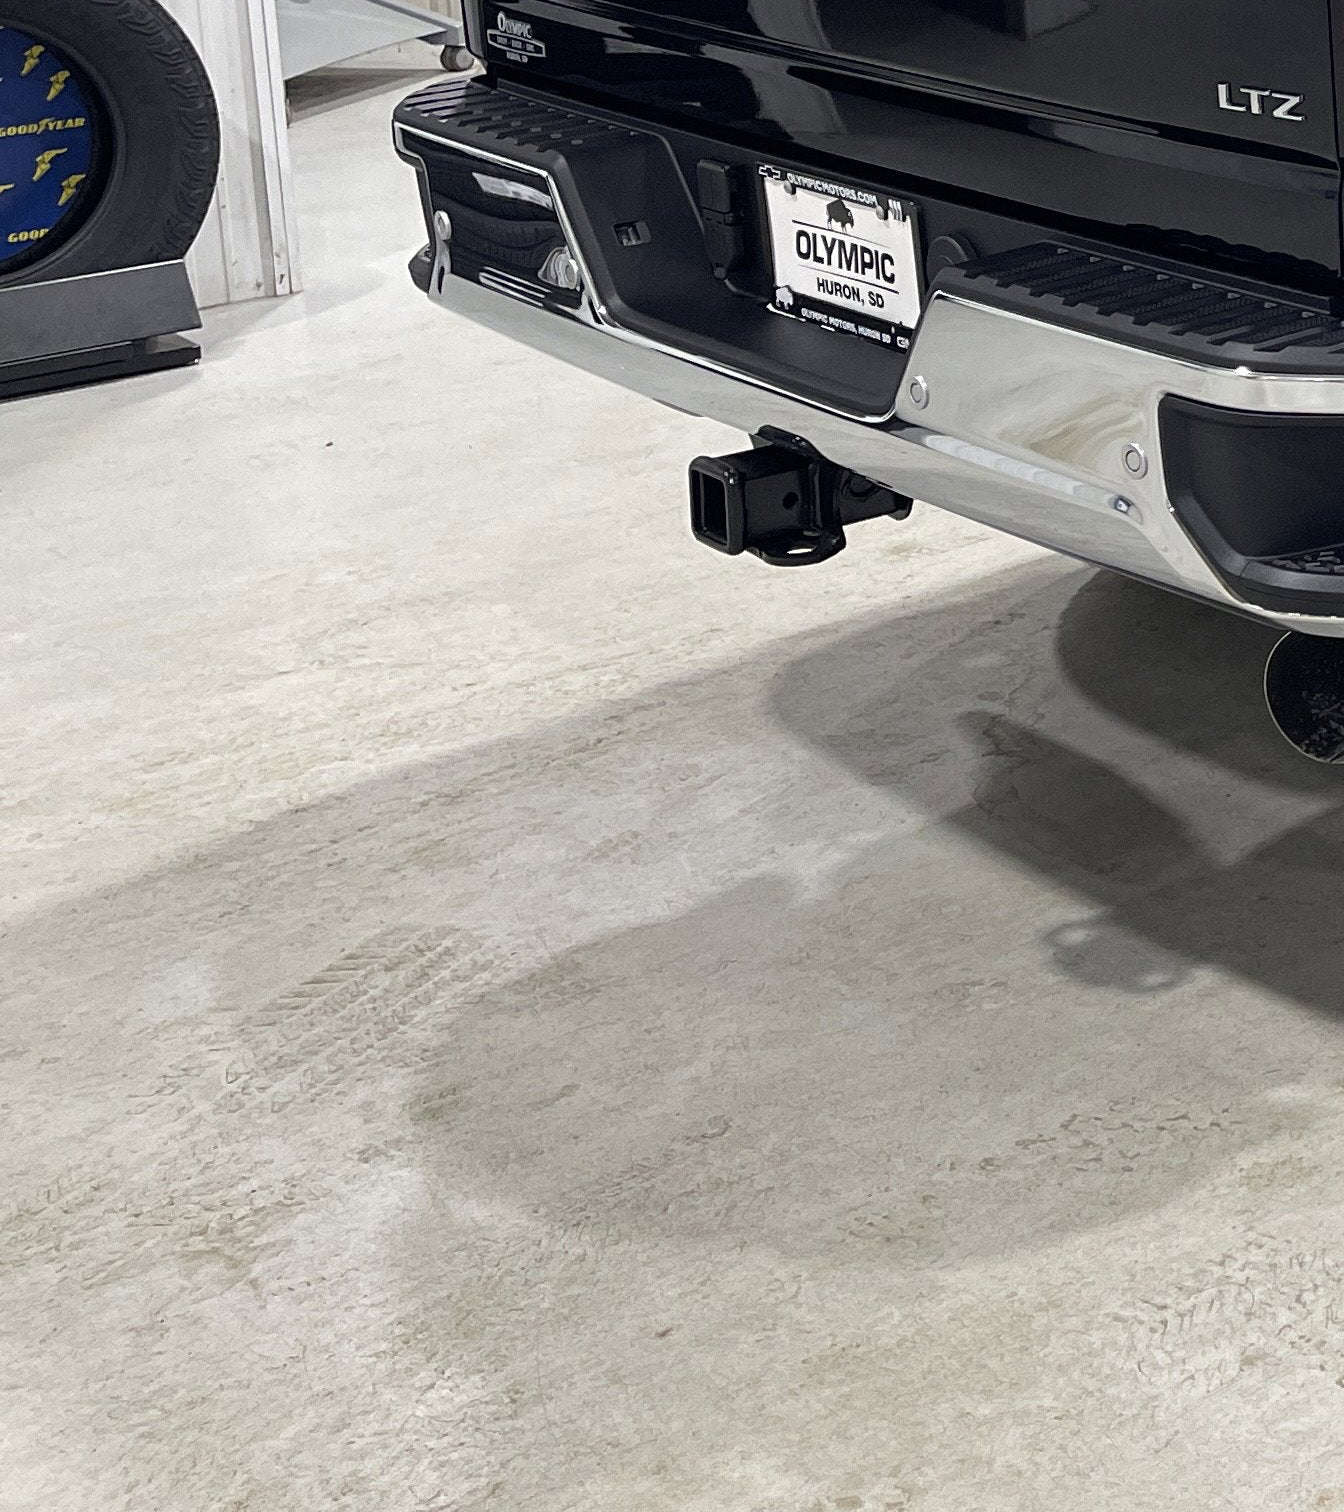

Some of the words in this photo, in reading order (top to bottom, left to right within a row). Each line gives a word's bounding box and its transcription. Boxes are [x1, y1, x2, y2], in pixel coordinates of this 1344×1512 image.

[1216, 81, 1305, 123] LTZ
[796, 229, 895, 284] OLYMPIC
[816, 277, 865, 306] HURON,
[868, 291, 884, 309] SD
